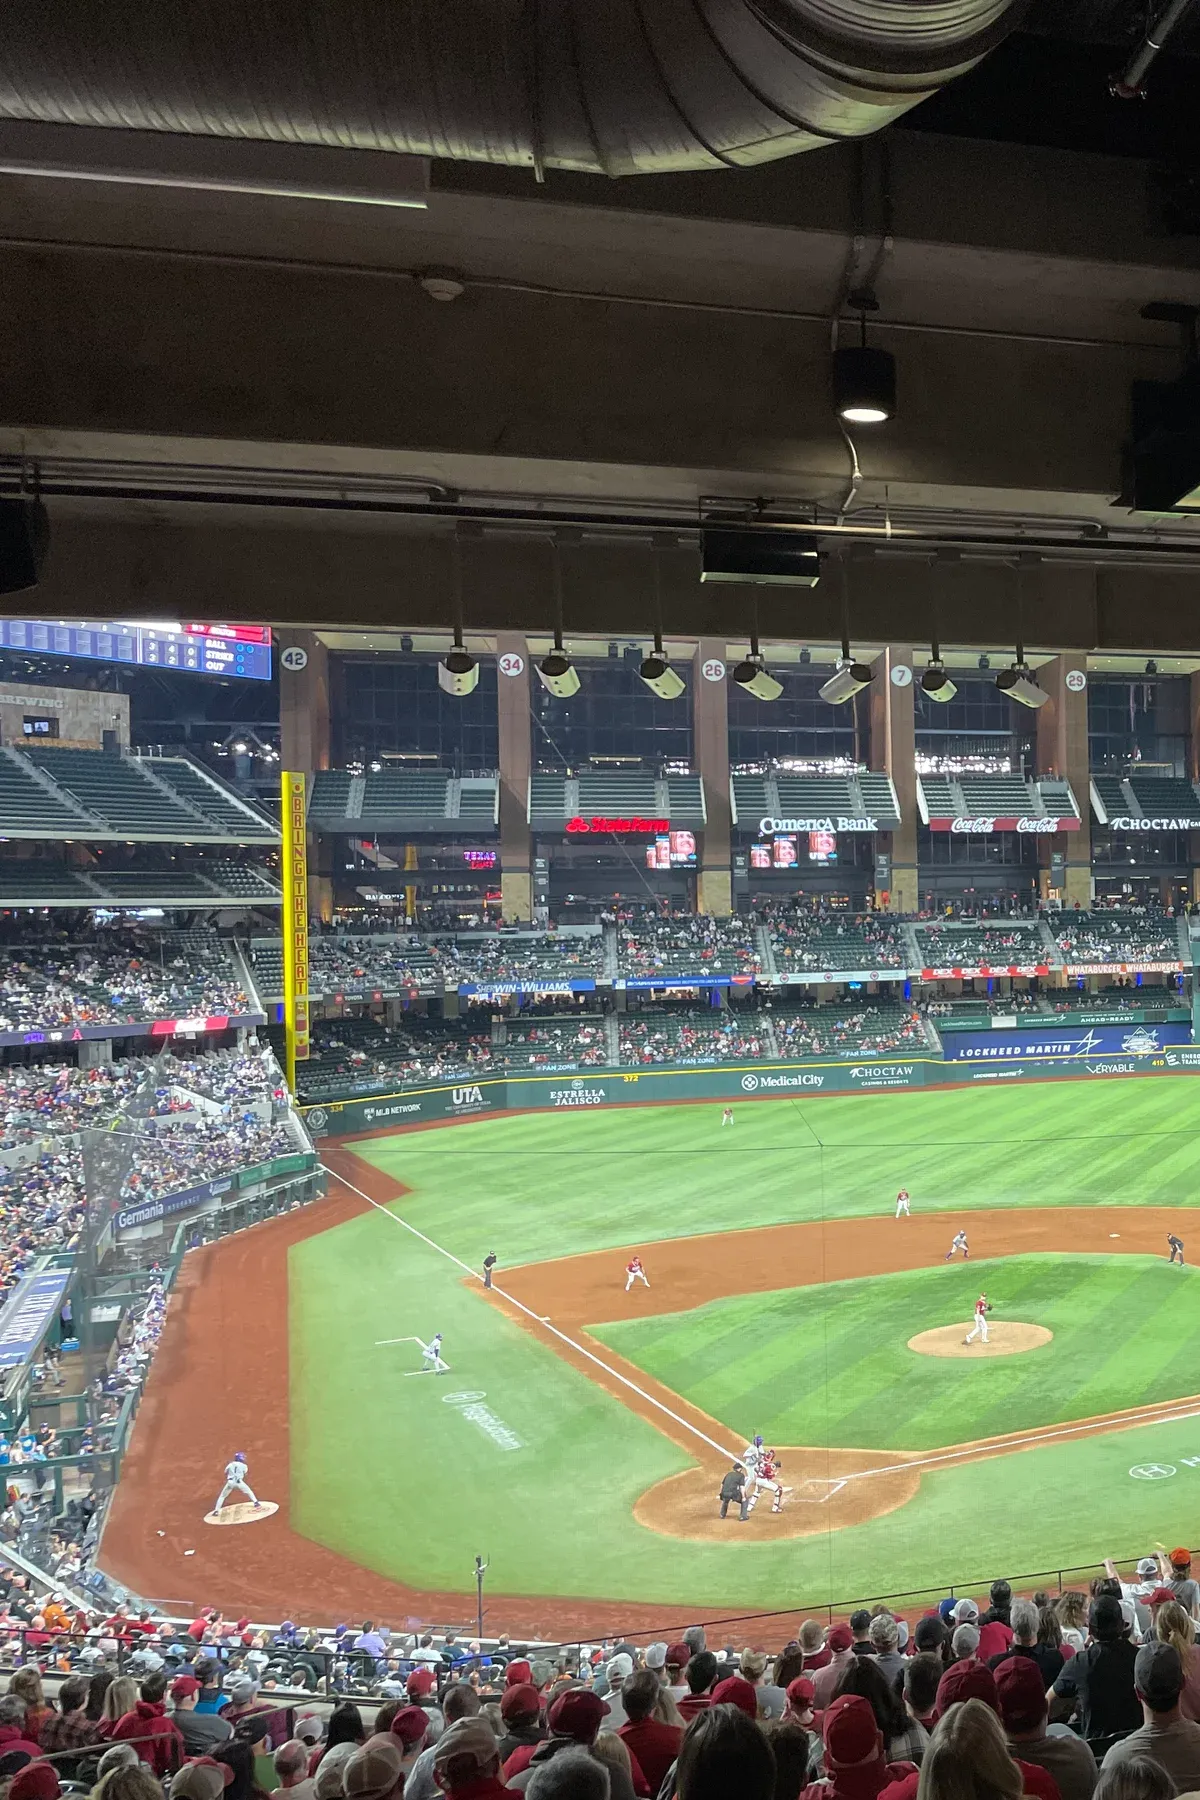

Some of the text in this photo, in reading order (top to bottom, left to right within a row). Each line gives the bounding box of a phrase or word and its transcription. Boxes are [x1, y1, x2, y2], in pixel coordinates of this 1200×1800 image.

[205, 640, 227, 650] BALL
[205, 650, 235, 662] STRIKE
[284, 651, 304, 666] 42
[205, 661, 226, 671] OUT
[502, 658, 522, 672] 34
[704, 664, 724, 677] 26
[896, 669, 907, 682] 7
[1068, 675, 1084, 687] 29
[836, 816, 879, 832] Bank
[951, 817, 997, 833] Coca-Cola
[1016, 817, 1061, 833] Coca-Cola
[1119, 817, 1191, 830] CHOCTAW
[464, 851, 497, 862] TEXAS
[670, 853, 688, 861] UTA
[809, 852, 828, 860] UTA
[1067, 964, 1121, 975] WHATABURGER
[1126, 963, 1179, 973] WHATABURGER
[50, 1031, 63, 1041] VS
[71, 1029, 83, 1041] A
[960, 1044, 1071, 1057] LOCKHEED MARTIN
[542, 1063, 577, 1072] FAN ZONE
[857, 1066, 914, 1077] CHOCTAW
[623, 1075, 639, 1083] 372
[760, 1074, 825, 1087] Medical City
[452, 1086, 483, 1104] UTA
[550, 1088, 605, 1099] ESTRELLA
[555, 1096, 601, 1106] JALISCO
[330, 1104, 343, 1113] 334
[376, 1103, 422, 1117] MLB NETWORK
[119, 1196, 201, 1228] Germania INSURANCE
